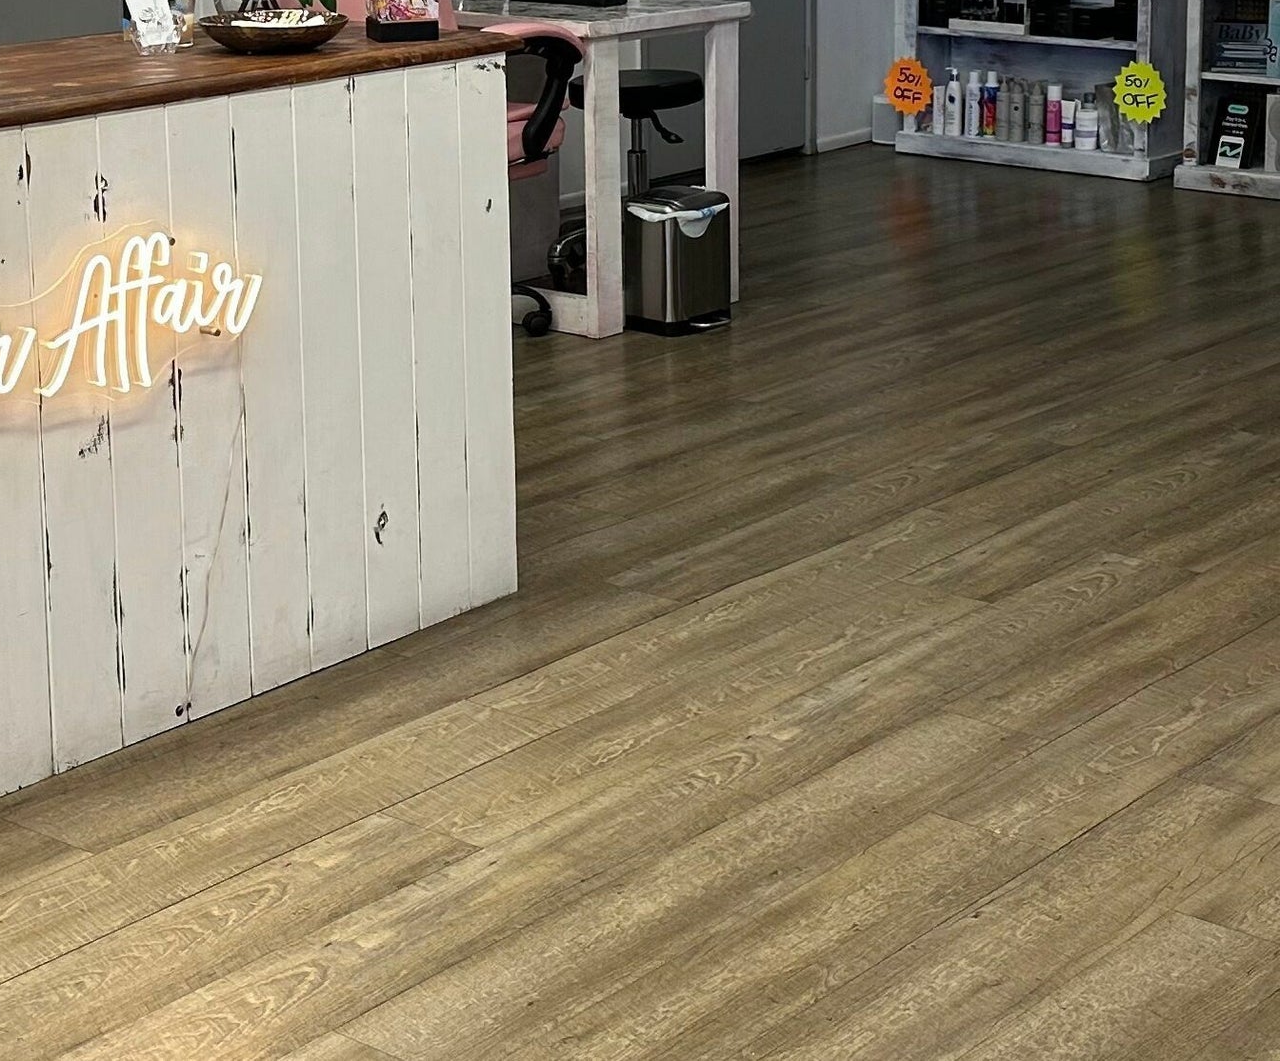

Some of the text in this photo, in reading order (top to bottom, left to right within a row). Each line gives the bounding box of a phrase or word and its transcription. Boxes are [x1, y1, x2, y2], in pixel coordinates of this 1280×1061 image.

[897, 67, 923, 87] 50%
[1124, 74, 1150, 88] 50%
[894, 86, 923, 104] OFF
[1122, 92, 1158, 109] OFF
[36, 232, 262, 397] Affair
